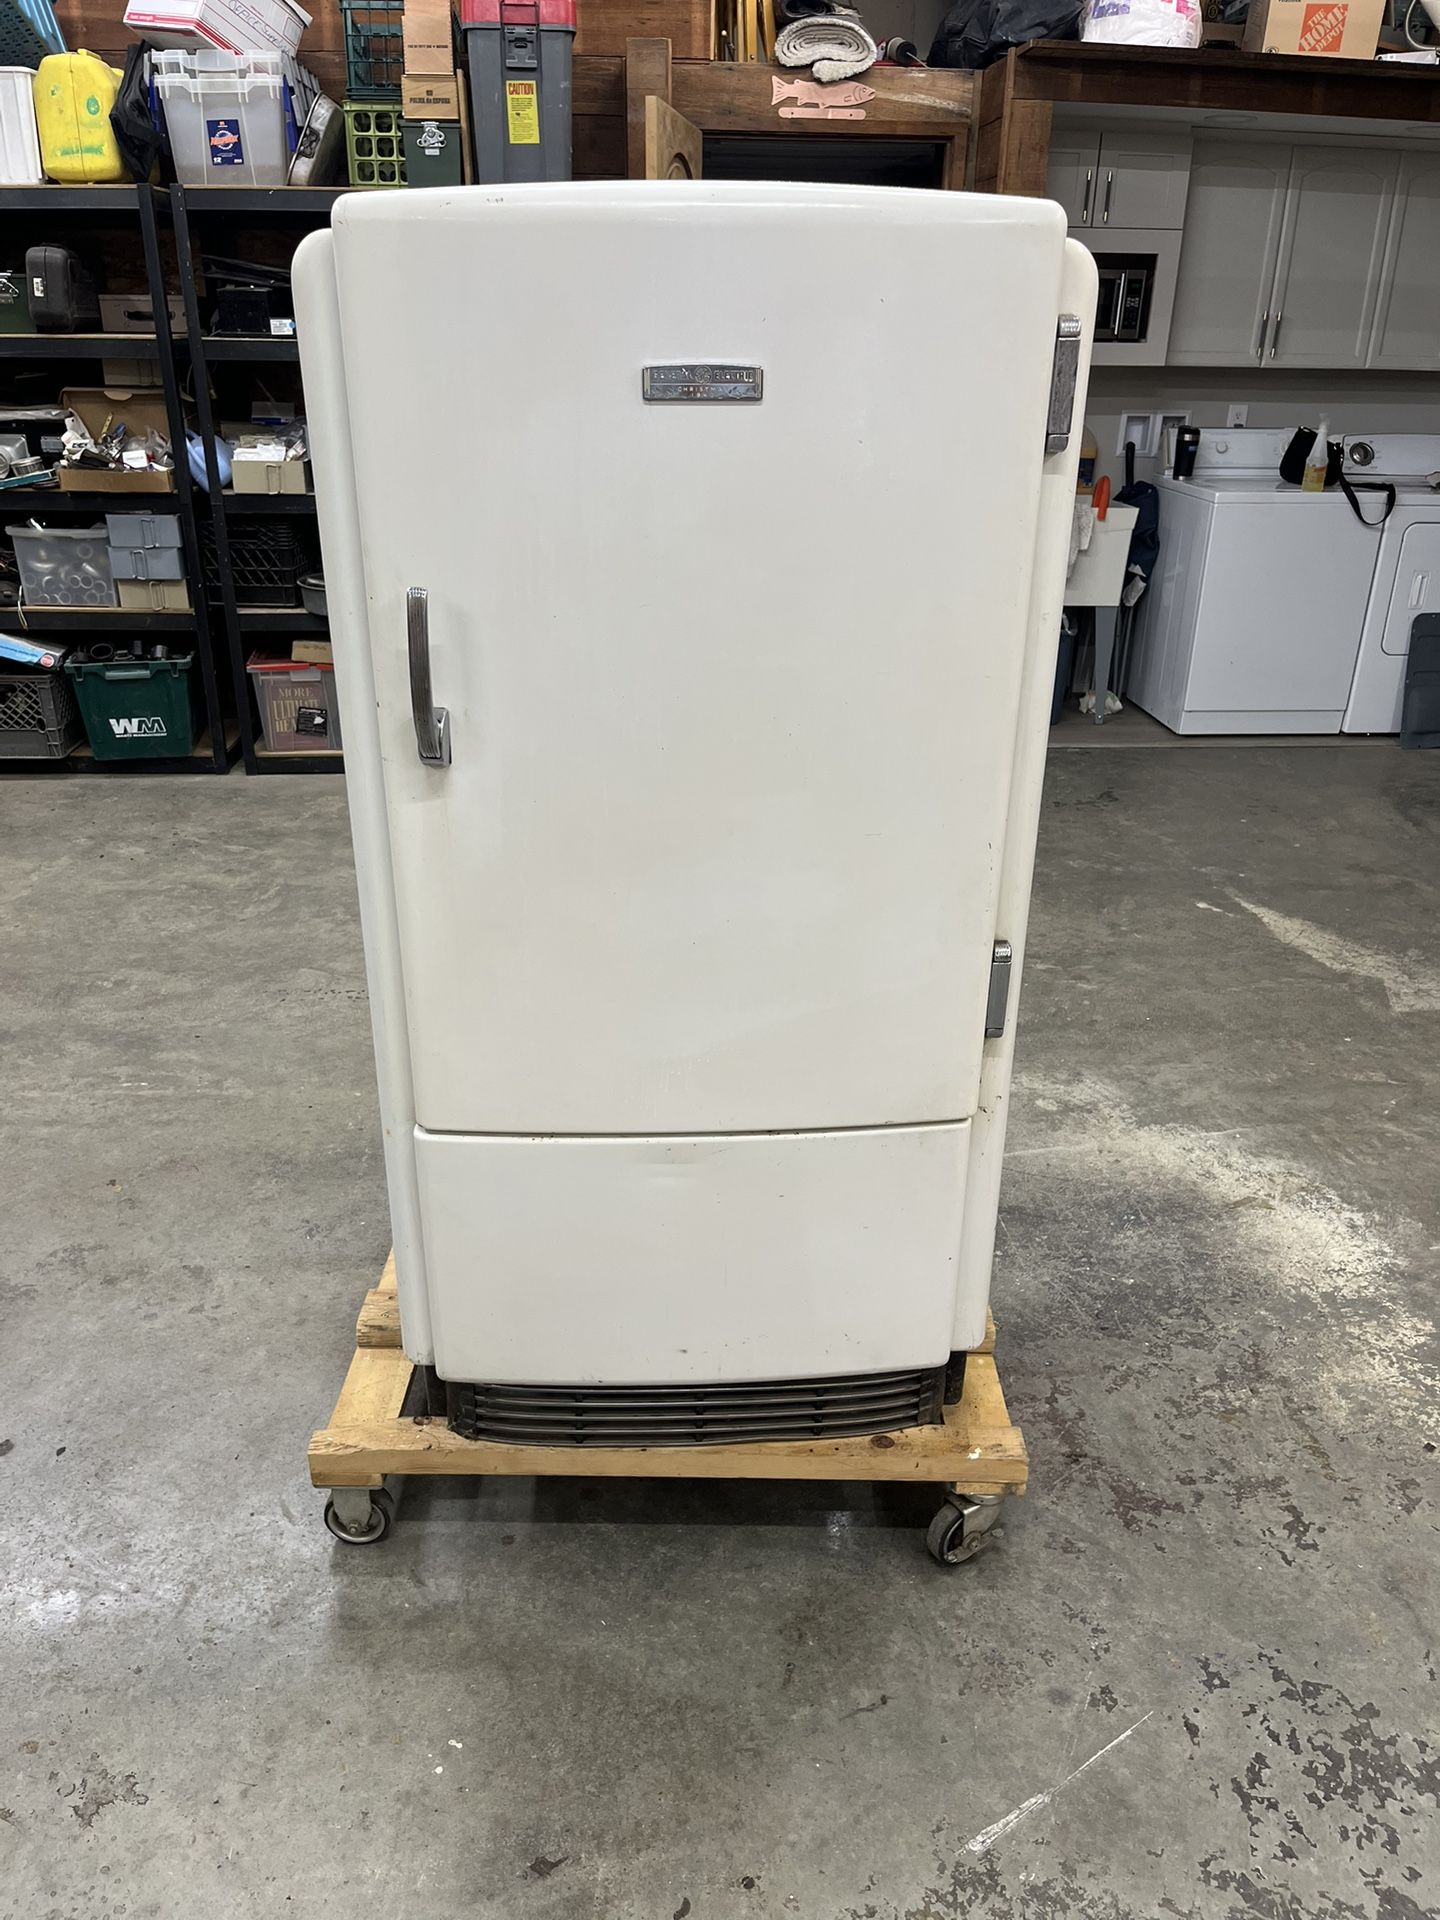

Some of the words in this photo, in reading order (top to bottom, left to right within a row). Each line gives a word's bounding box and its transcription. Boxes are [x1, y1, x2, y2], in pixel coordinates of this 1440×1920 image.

[1300, 4, 1348, 51] HOME
[1307, 9, 1327, 29] THE
[1315, 23, 1343, 51] DEPOT
[509, 83, 534, 95] CAUTION
[279, 687, 315, 698] MORE
[109, 717, 167, 734] WM
